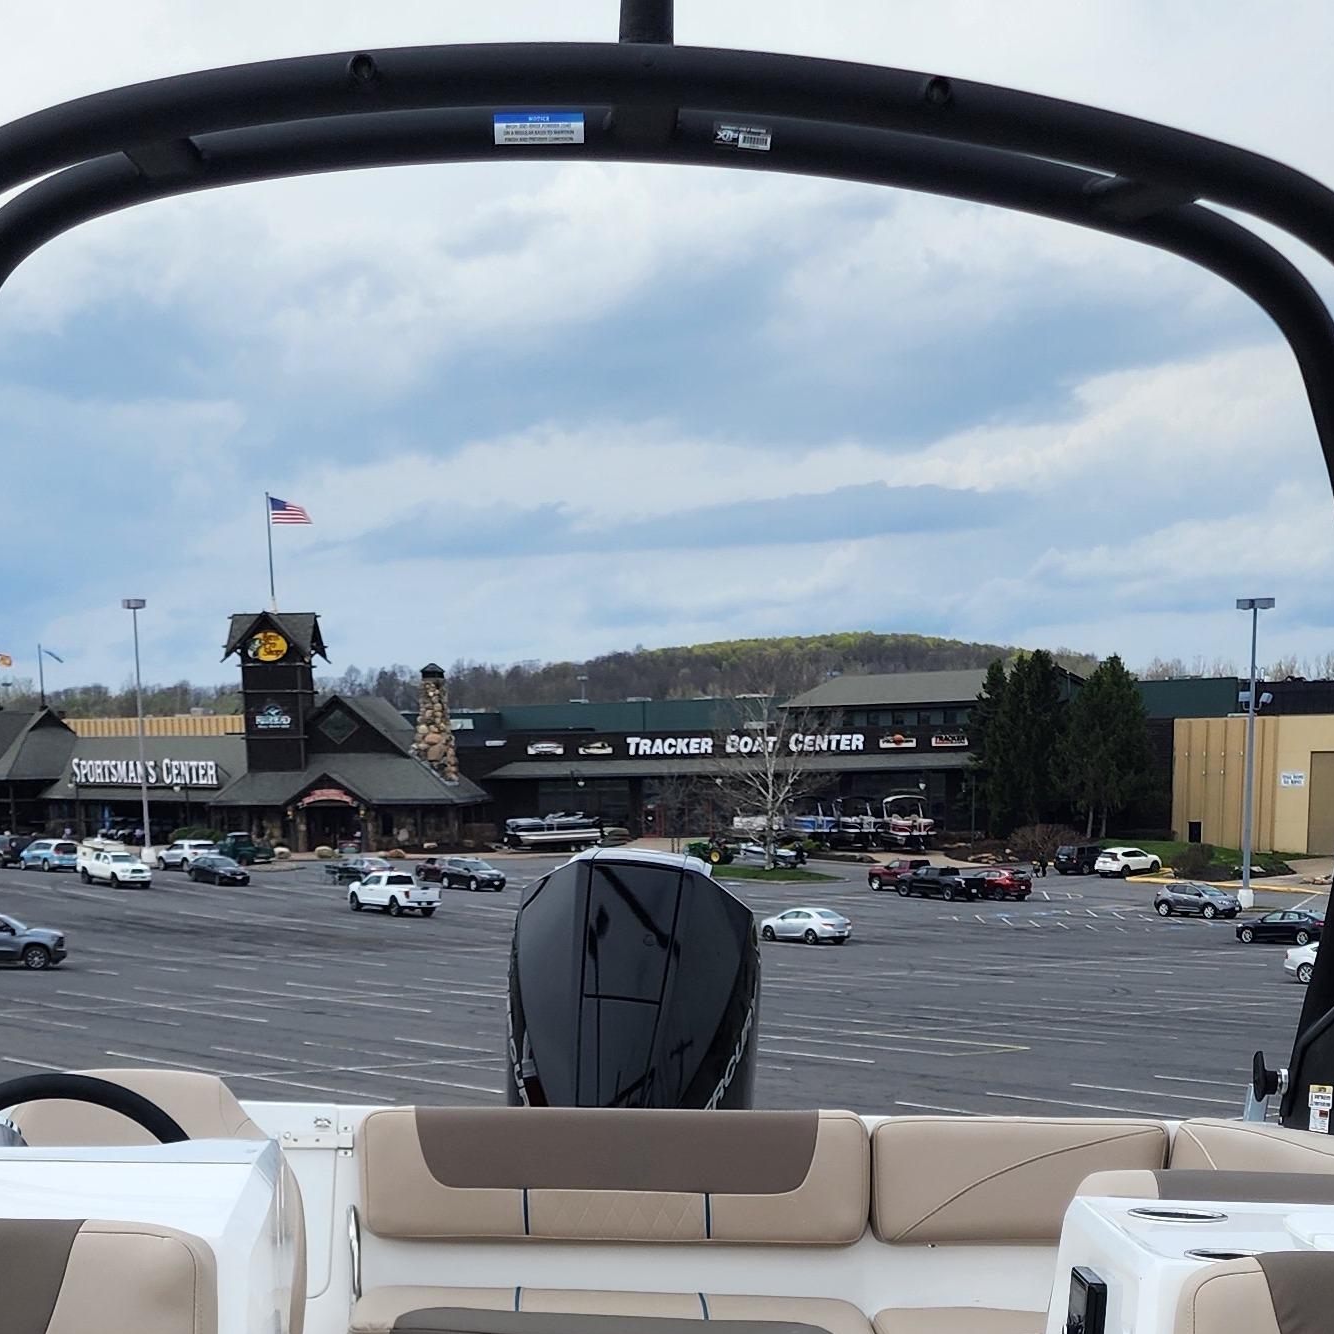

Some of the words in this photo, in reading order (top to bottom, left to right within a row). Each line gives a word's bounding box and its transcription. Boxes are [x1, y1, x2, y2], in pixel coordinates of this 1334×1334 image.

[626, 737, 713, 756] TRACKER
[725, 735, 777, 753] BOAT
[788, 733, 864, 752] CENTER
[162, 758, 217, 785] CENTER
